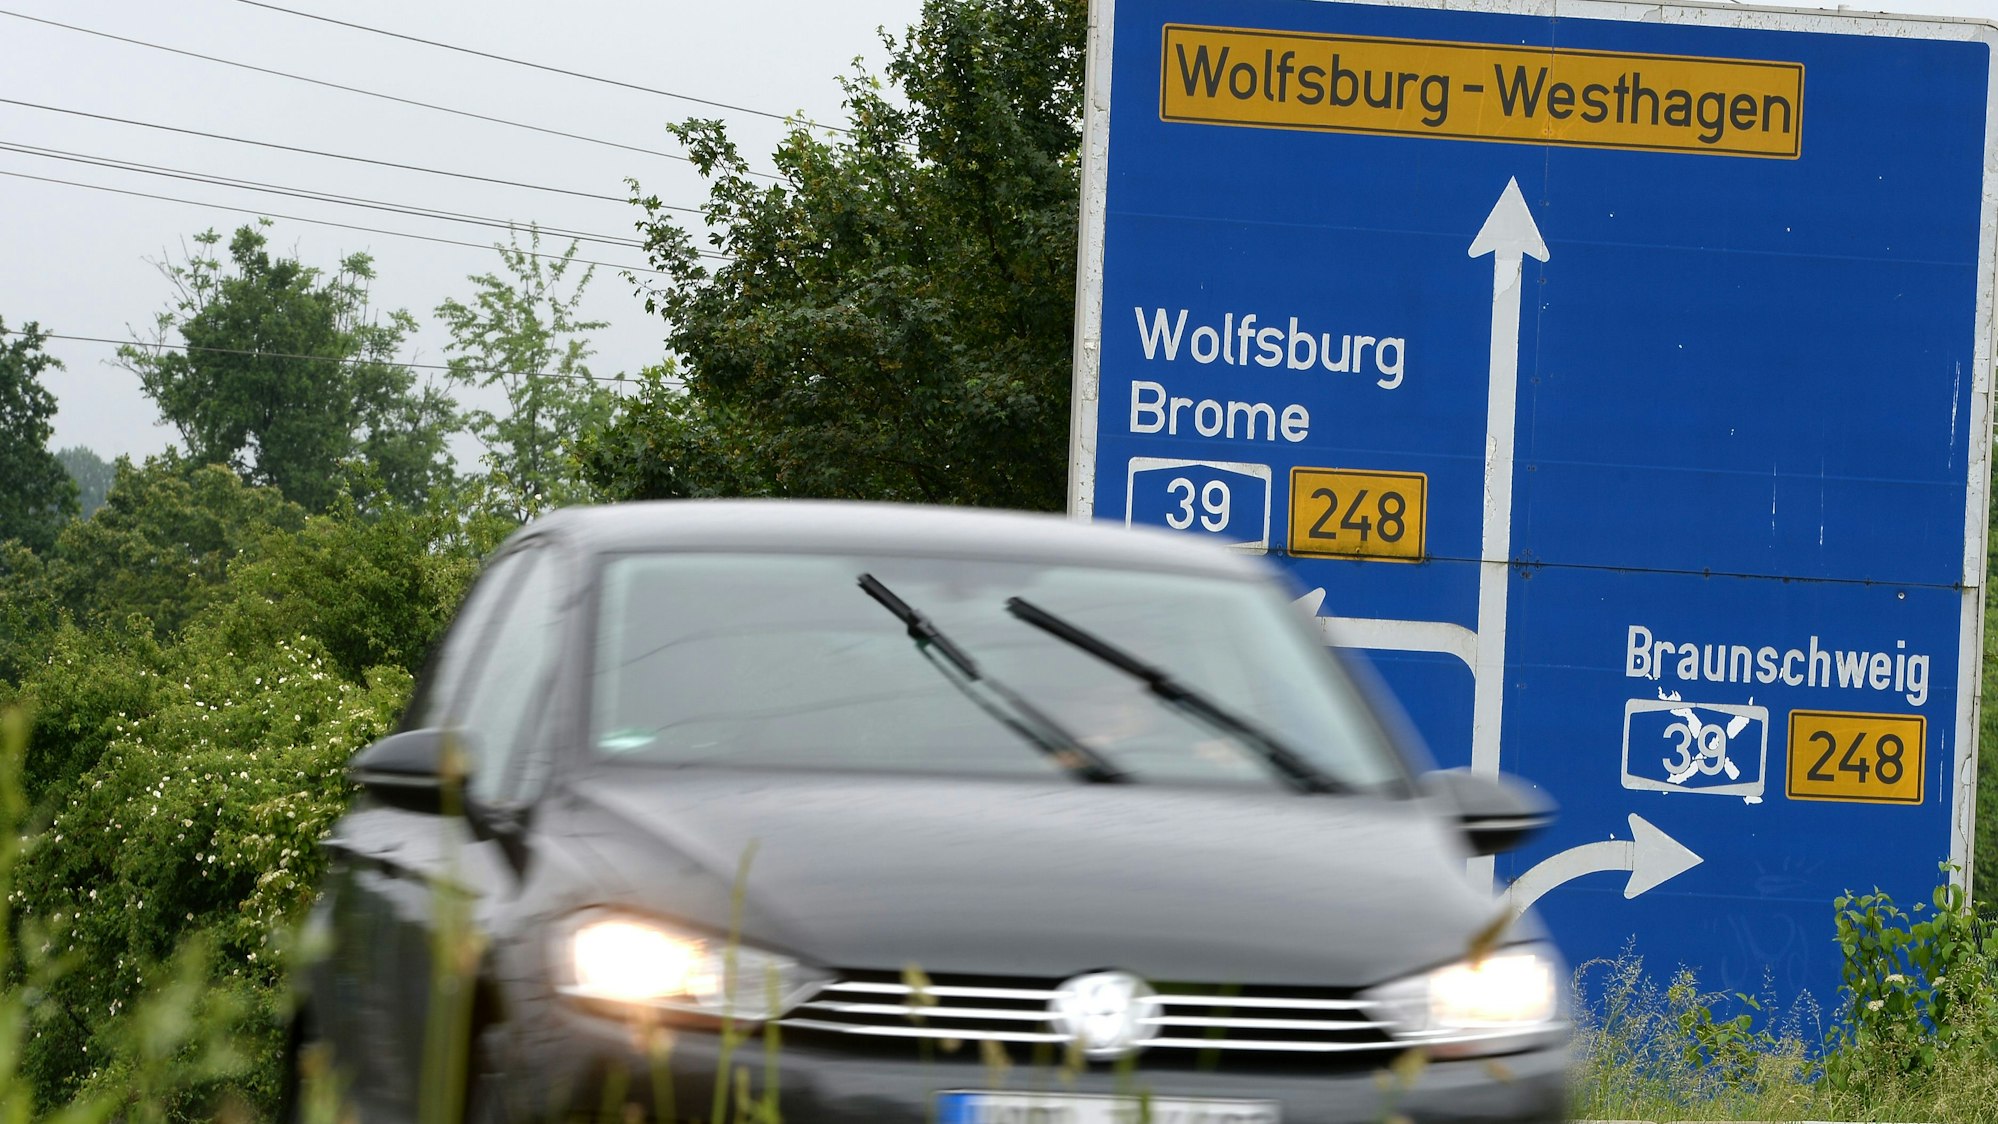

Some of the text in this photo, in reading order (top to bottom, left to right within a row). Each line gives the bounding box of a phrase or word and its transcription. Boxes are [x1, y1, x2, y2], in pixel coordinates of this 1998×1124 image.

[1134, 306, 1405, 390] Wolfsburg
[1130, 380, 1309, 443] Brome
[1165, 477, 1231, 532] 39
[1308, 488, 1406, 543] 248
[1625, 624, 1930, 707] Braunschweig
[1662, 722, 1727, 776] 39
[1807, 730, 1905, 785] 248
